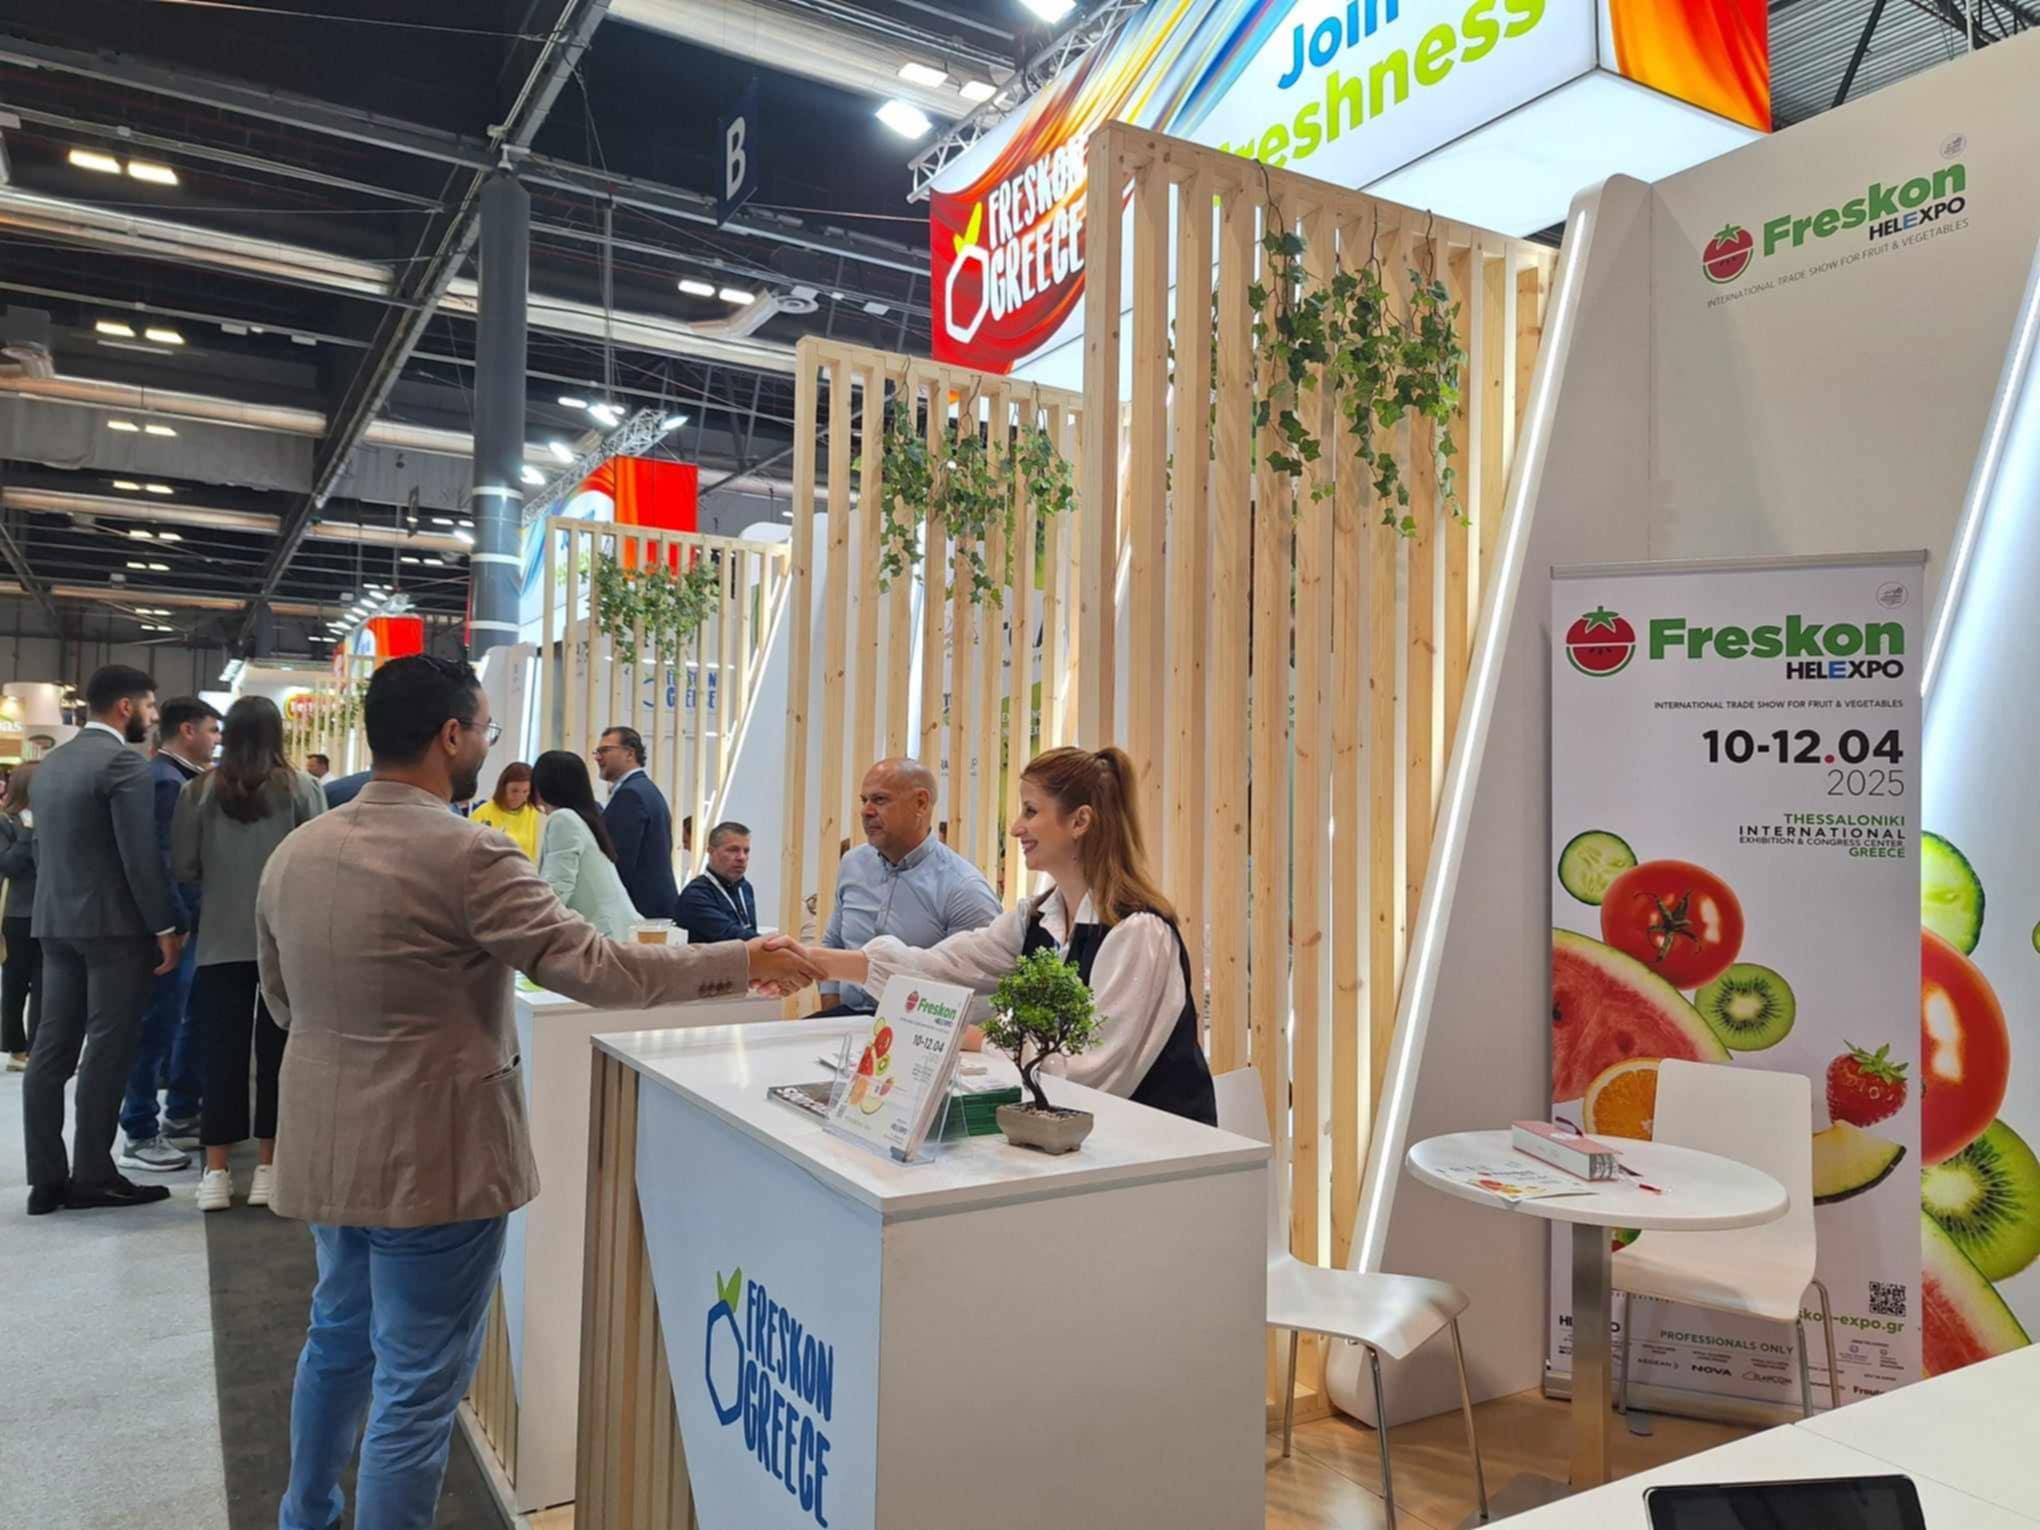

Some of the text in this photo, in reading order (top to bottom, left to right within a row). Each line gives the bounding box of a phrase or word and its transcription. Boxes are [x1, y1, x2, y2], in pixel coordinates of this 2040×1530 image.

[1218, 0, 1545, 169] eshness
[726, 116, 746, 201] B
[1763, 163, 1967, 256] Freskon
[1869, 196, 1967, 241] HELEXPO
[990, 198, 1086, 321] GREECE
[1706, 218, 1970, 308] INTERNATIONAL TRADE SHOW FOR FRUIT & VEGETABLES
[1649, 614, 1905, 660] Freskon
[1786, 659, 1905, 680] HELEXPO
[1654, 698, 1904, 710] INTERNATIONAL TRADE SHOW FOR FRUIT & VEGETABLES
[1702, 729, 1904, 764] 10-12.04
[1827, 768, 1905, 797] 2025
[1738, 825, 1906, 840] INTERNATIONAL
[1784, 813, 1905, 827] THESSALONIKI
[1739, 835, 1904, 848] EXHIBITION & CONGRESS CENTER
[1848, 847, 1906, 859] GREECE
[746, 1279, 833, 1423] FRESKON
[1660, 1329, 1757, 1351] PROFESSIONALS
[1759, 1342, 1795, 1356] ONLY
[1691, 1363, 1733, 1377] NOVA
[743, 1359, 832, 1529] GREECE
